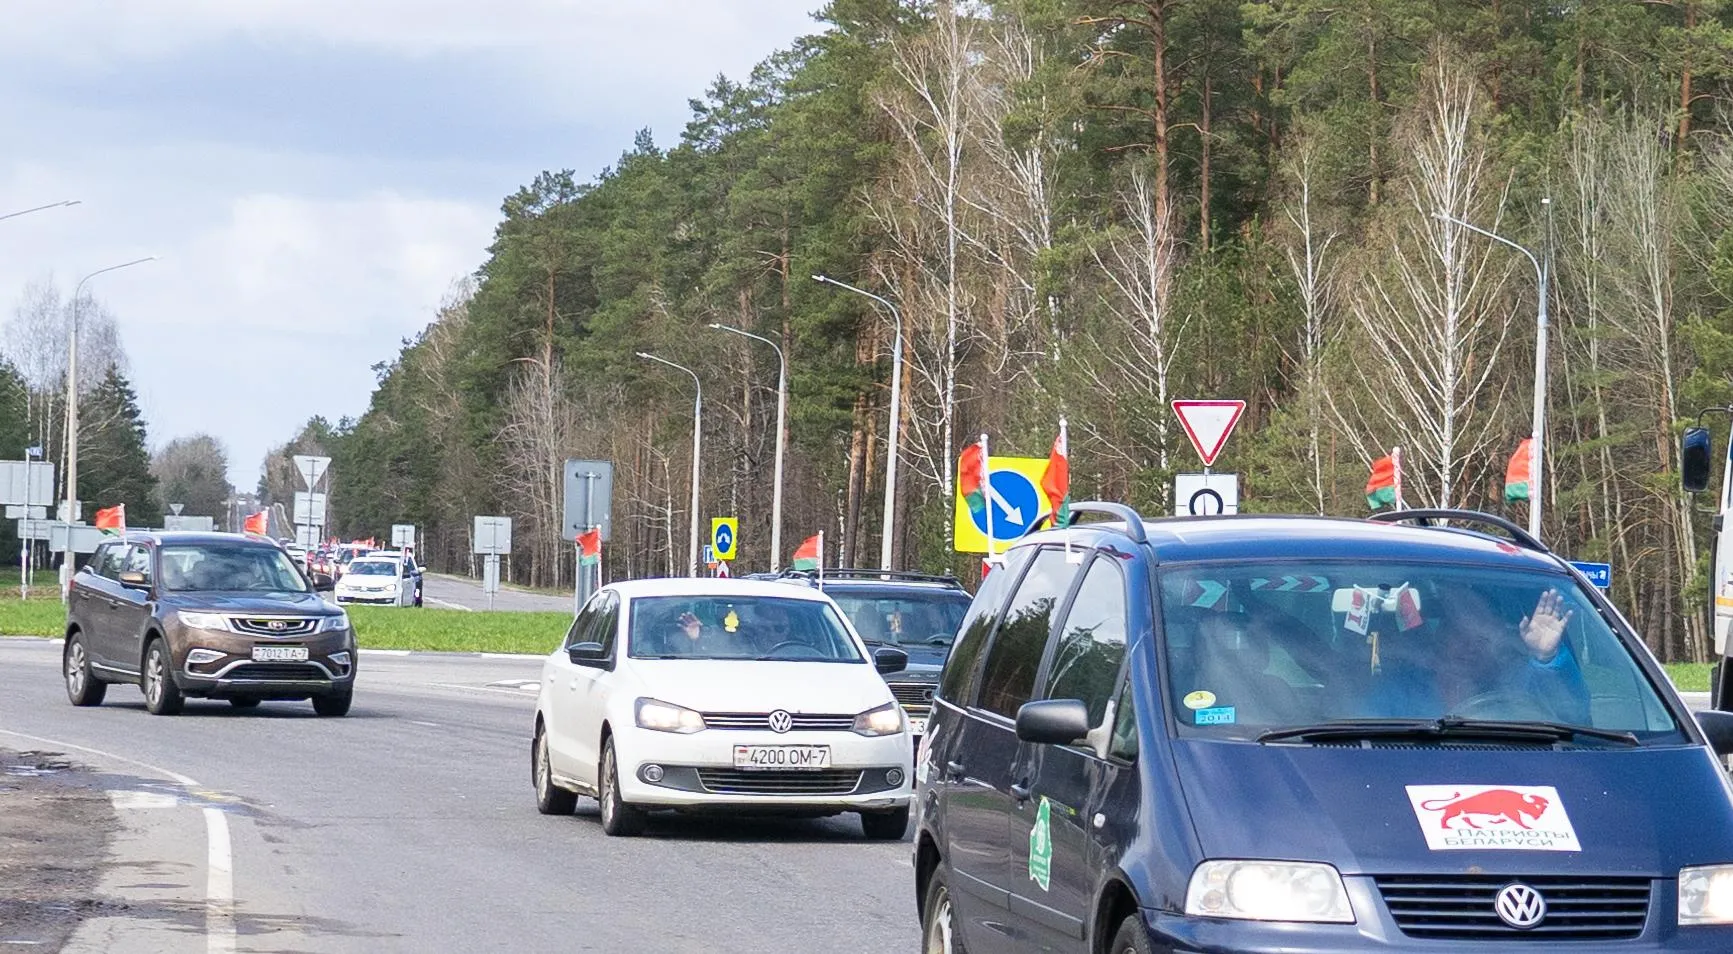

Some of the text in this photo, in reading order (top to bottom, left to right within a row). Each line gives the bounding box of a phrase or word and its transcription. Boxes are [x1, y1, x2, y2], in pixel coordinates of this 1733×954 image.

[262, 648, 282, 658] 7012
[750, 749, 827, 765] 4200 OM-7
[1445, 837, 1554, 847] БЕЛАРУСИ
